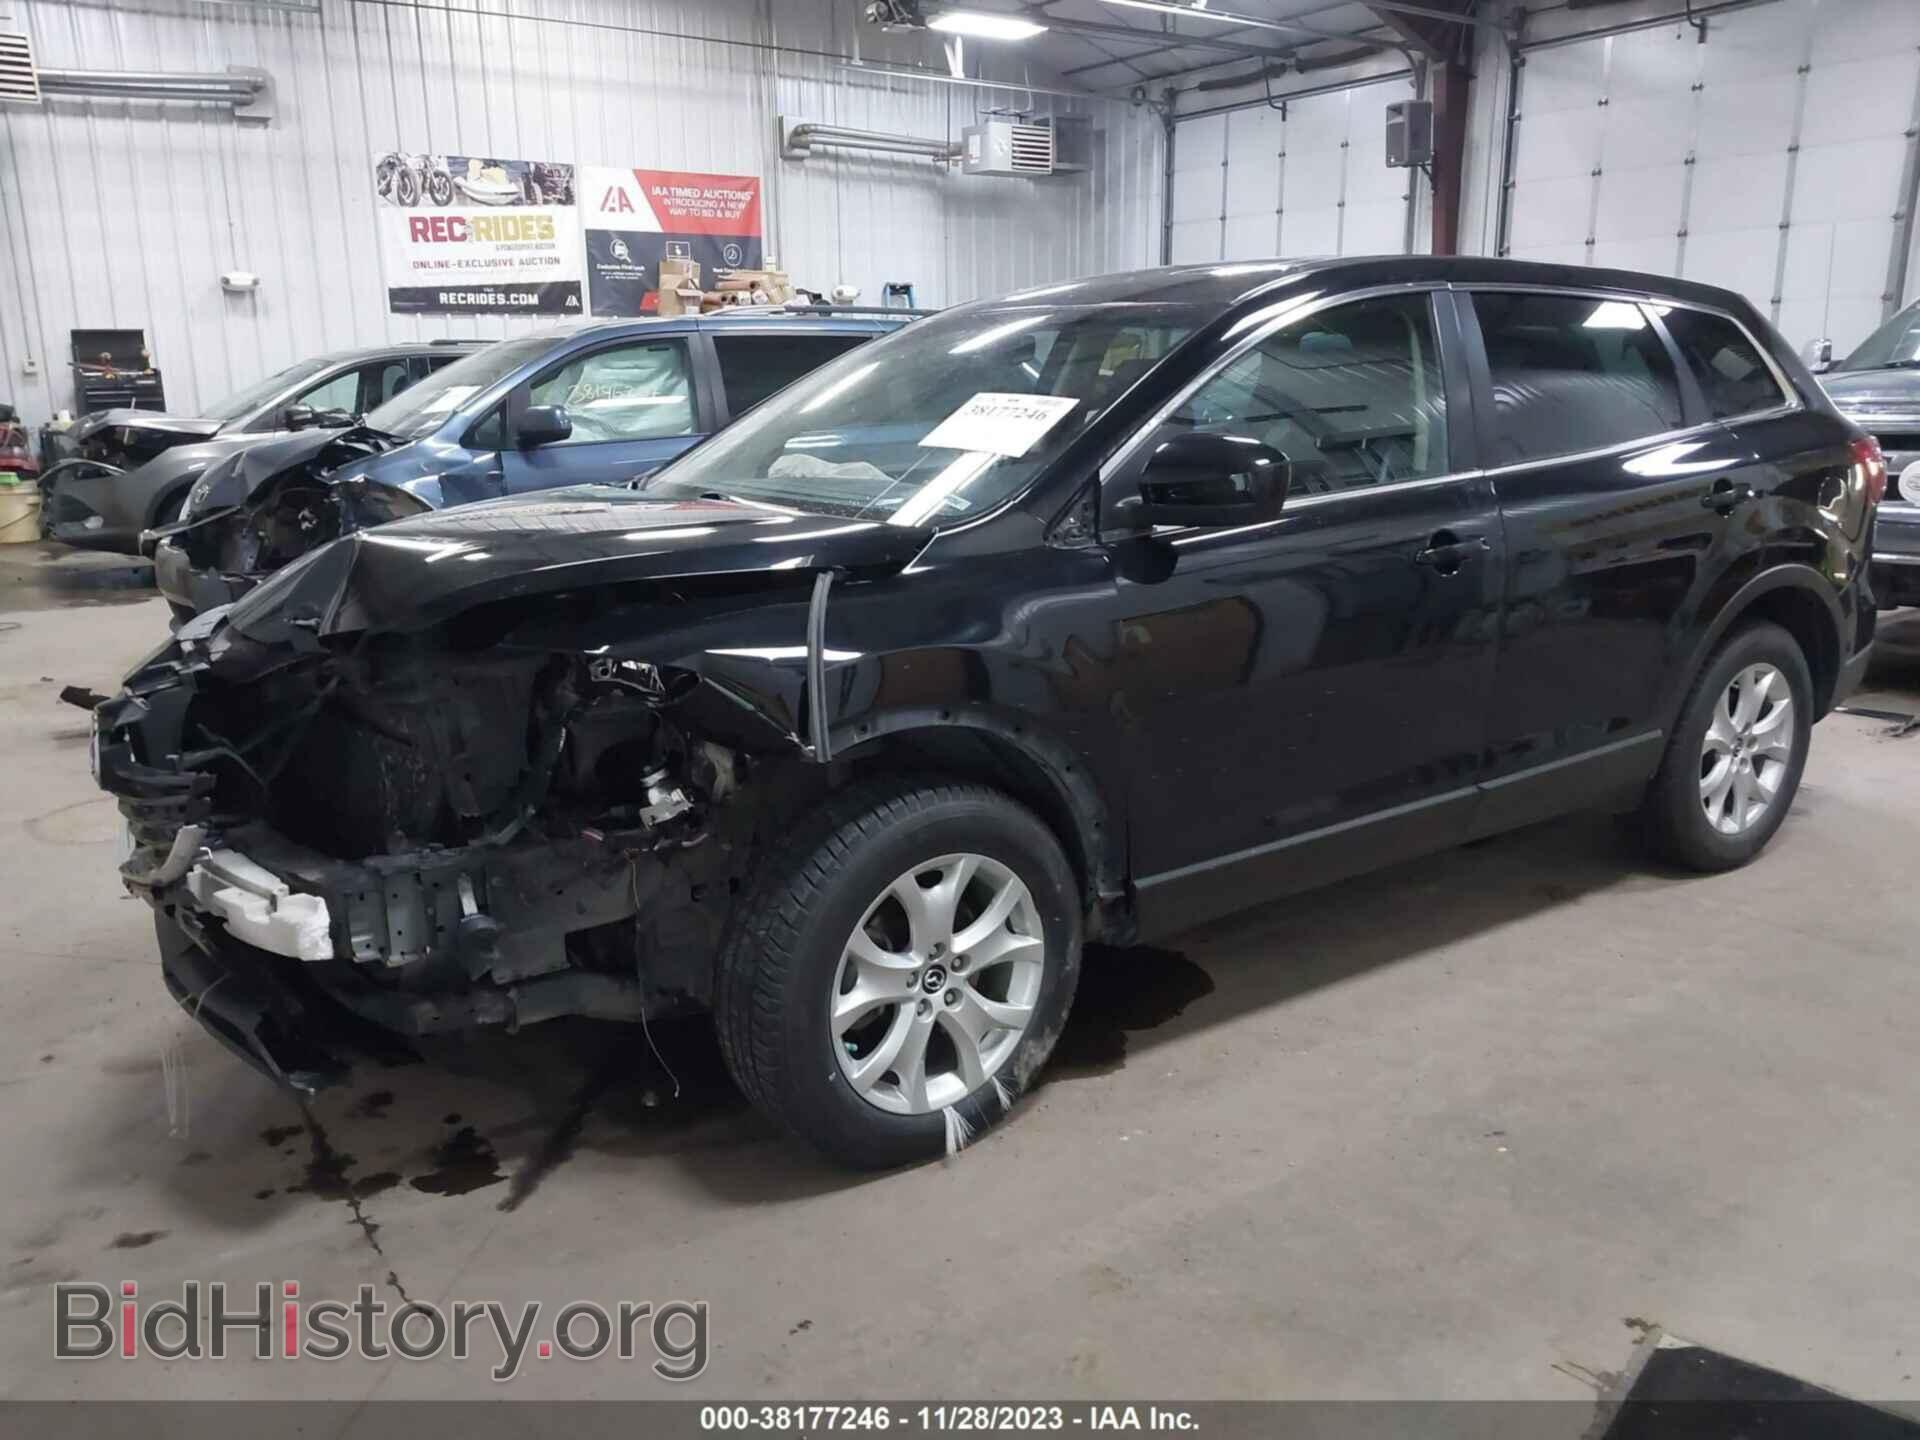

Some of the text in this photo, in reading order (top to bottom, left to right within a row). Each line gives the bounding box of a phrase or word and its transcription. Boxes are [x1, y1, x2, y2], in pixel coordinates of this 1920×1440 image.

[671, 186, 700, 198] TIMED
[664, 198, 747, 210] INTRODUCING A NEW
[670, 207, 686, 216] WAY
[688, 208, 700, 217] TO
[702, 209, 715, 218] BID
[725, 210, 741, 220] BUY
[409, 216, 468, 243] REC
[472, 215, 556, 241] RIDES
[412, 256, 561, 269] ONLINE-EXCLUSIVE AUCTION
[439, 293, 539, 306] RECRIDES.COM
